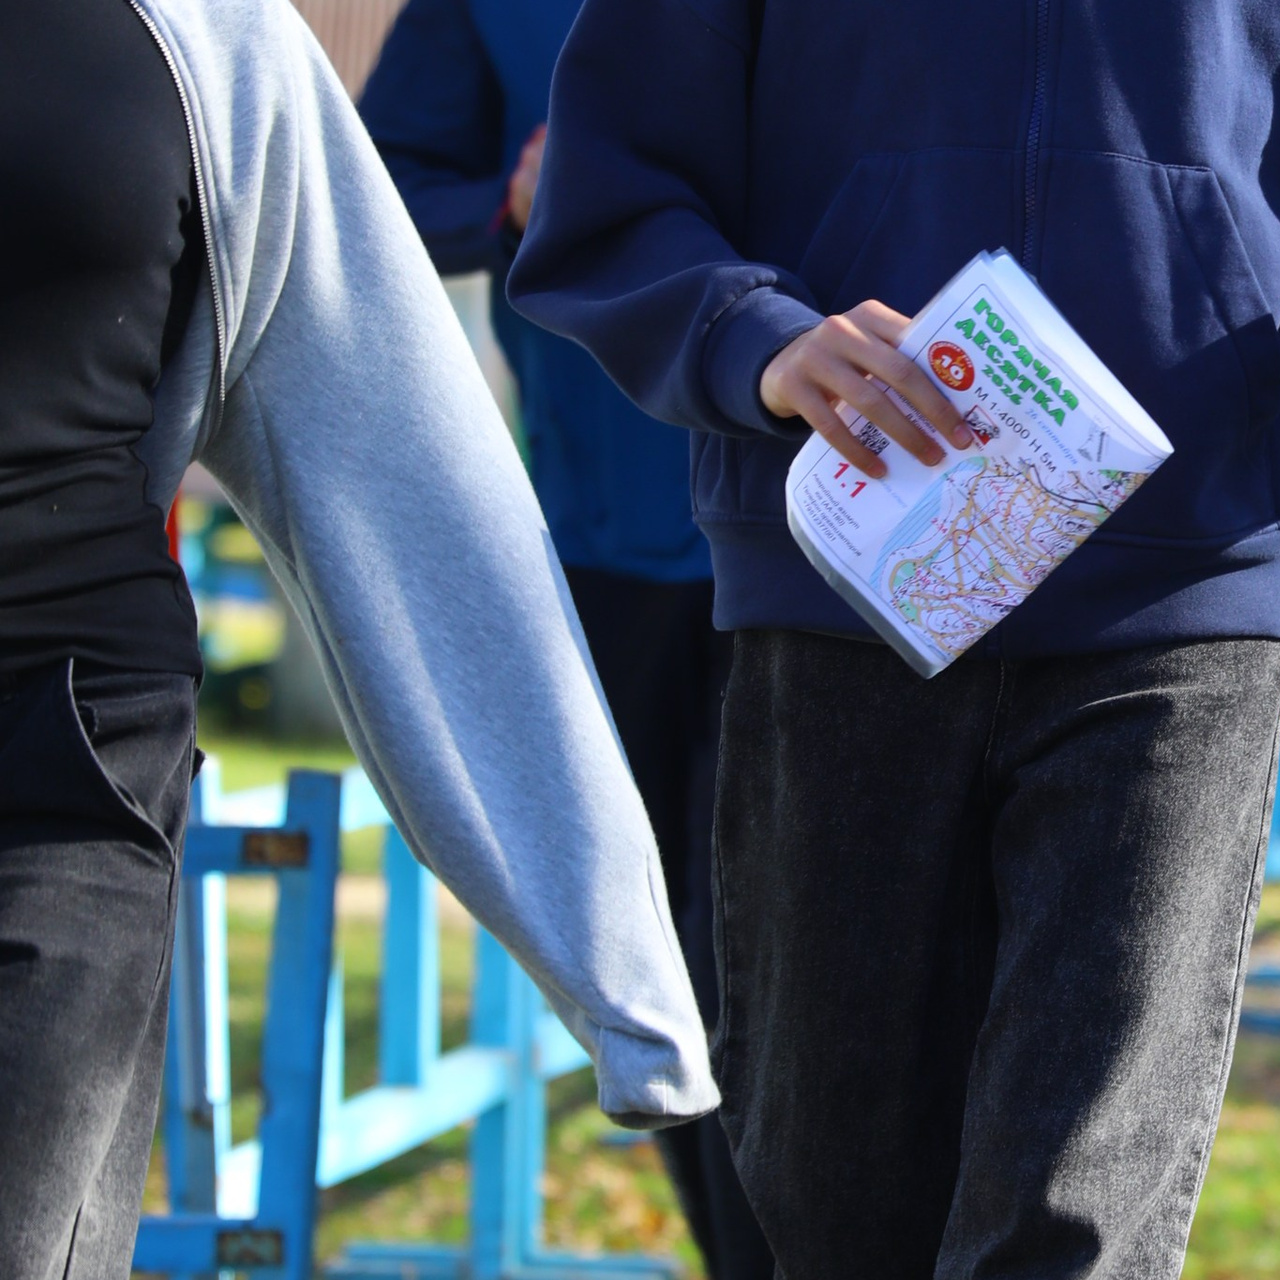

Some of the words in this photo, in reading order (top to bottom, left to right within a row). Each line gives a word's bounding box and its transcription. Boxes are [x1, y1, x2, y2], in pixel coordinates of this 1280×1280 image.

[939, 355, 964, 379] 10
[954, 318, 1066, 427] ДЕСЯТКА
[973, 297, 1079, 411] ГОРЯЧАЯ
[973, 386, 989, 402] М
[989, 402, 1029, 438] 1:4000
[1027, 438, 1042, 454] Н
[833, 462, 868, 498] 1.1
